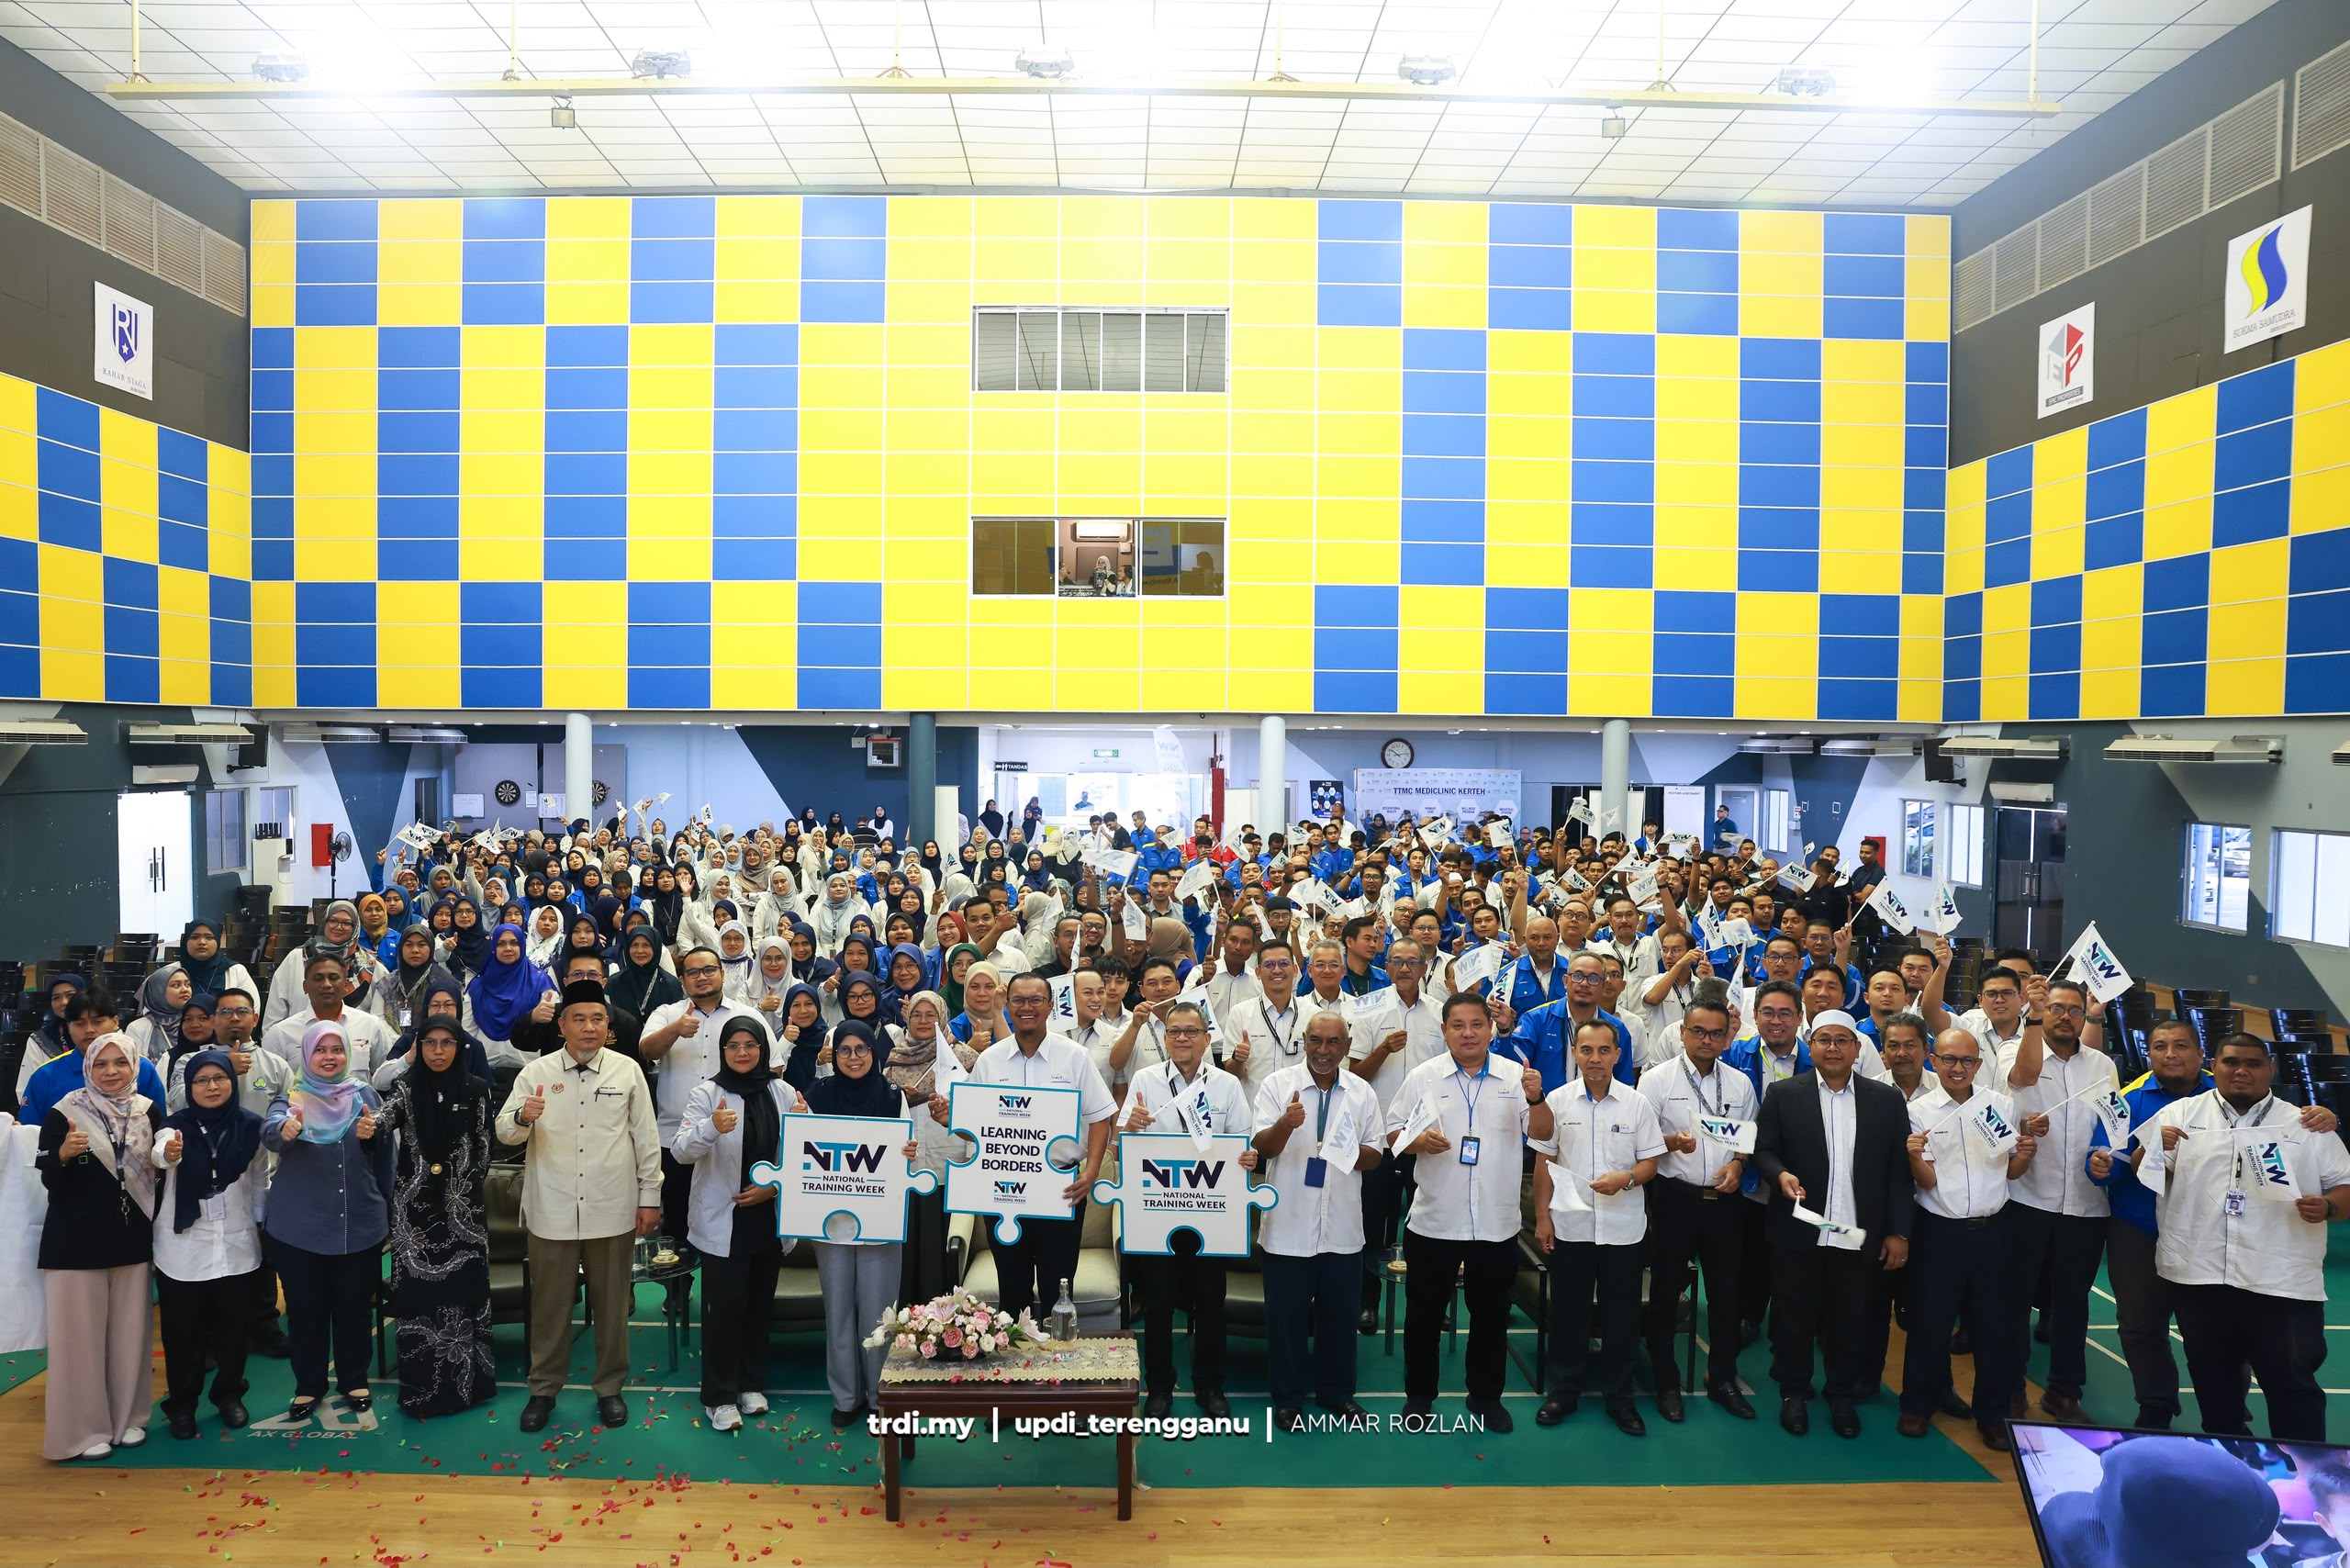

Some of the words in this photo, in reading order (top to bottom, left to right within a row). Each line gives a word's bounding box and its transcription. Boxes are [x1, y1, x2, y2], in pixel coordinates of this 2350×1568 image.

[2232, 322, 2258, 339] SUKMA
[2258, 308, 2296, 330] SAMUDRA
[1393, 787, 1414, 795] TTMC
[1415, 787, 1456, 795] MEDICLINIC
[1789, 865, 1809, 879] NTW
[1324, 889, 1342, 908] NTW
[1886, 890, 1908, 917] NTW
[1878, 902, 1893, 918] TRAINING
[1891, 916, 1901, 925] WEEK
[2091, 942, 2121, 979] NTW
[2091, 976, 2102, 990] WEEK
[1059, 986, 1074, 1017] NTW
[999, 1095, 1032, 1109] NTW
[2096, 1099, 2113, 1122] TRAINING
[1194, 1124, 1203, 1137] WEEK
[1701, 1119, 1741, 1137] NTW
[1986, 1104, 2012, 1138] NTW
[980, 1126, 1046, 1141] LEARNING
[1973, 1117, 1990, 1138] TRAINING
[1987, 1137, 1997, 1148] WEEK
[803, 1141, 888, 1173] NTW
[986, 1143, 1040, 1157] BEYOND
[981, 1159, 1043, 1173] BORDERS
[2246, 1146, 2258, 1171] TRAINING
[2255, 1172, 2265, 1186] WEEK
[2255, 1155, 2266, 1177] NATIONAL
[2262, 1142, 2289, 1186] NTW
[822, 1175, 866, 1183] NATIONAL
[1142, 1159, 1225, 1189] NTW
[801, 1182, 853, 1193] TRAINING
[856, 1185, 886, 1193] WEEK
[994, 1181, 1027, 1194] NTW
[1143, 1199, 1193, 1208] TRAINING
[1196, 1201, 1226, 1209] WEEK
